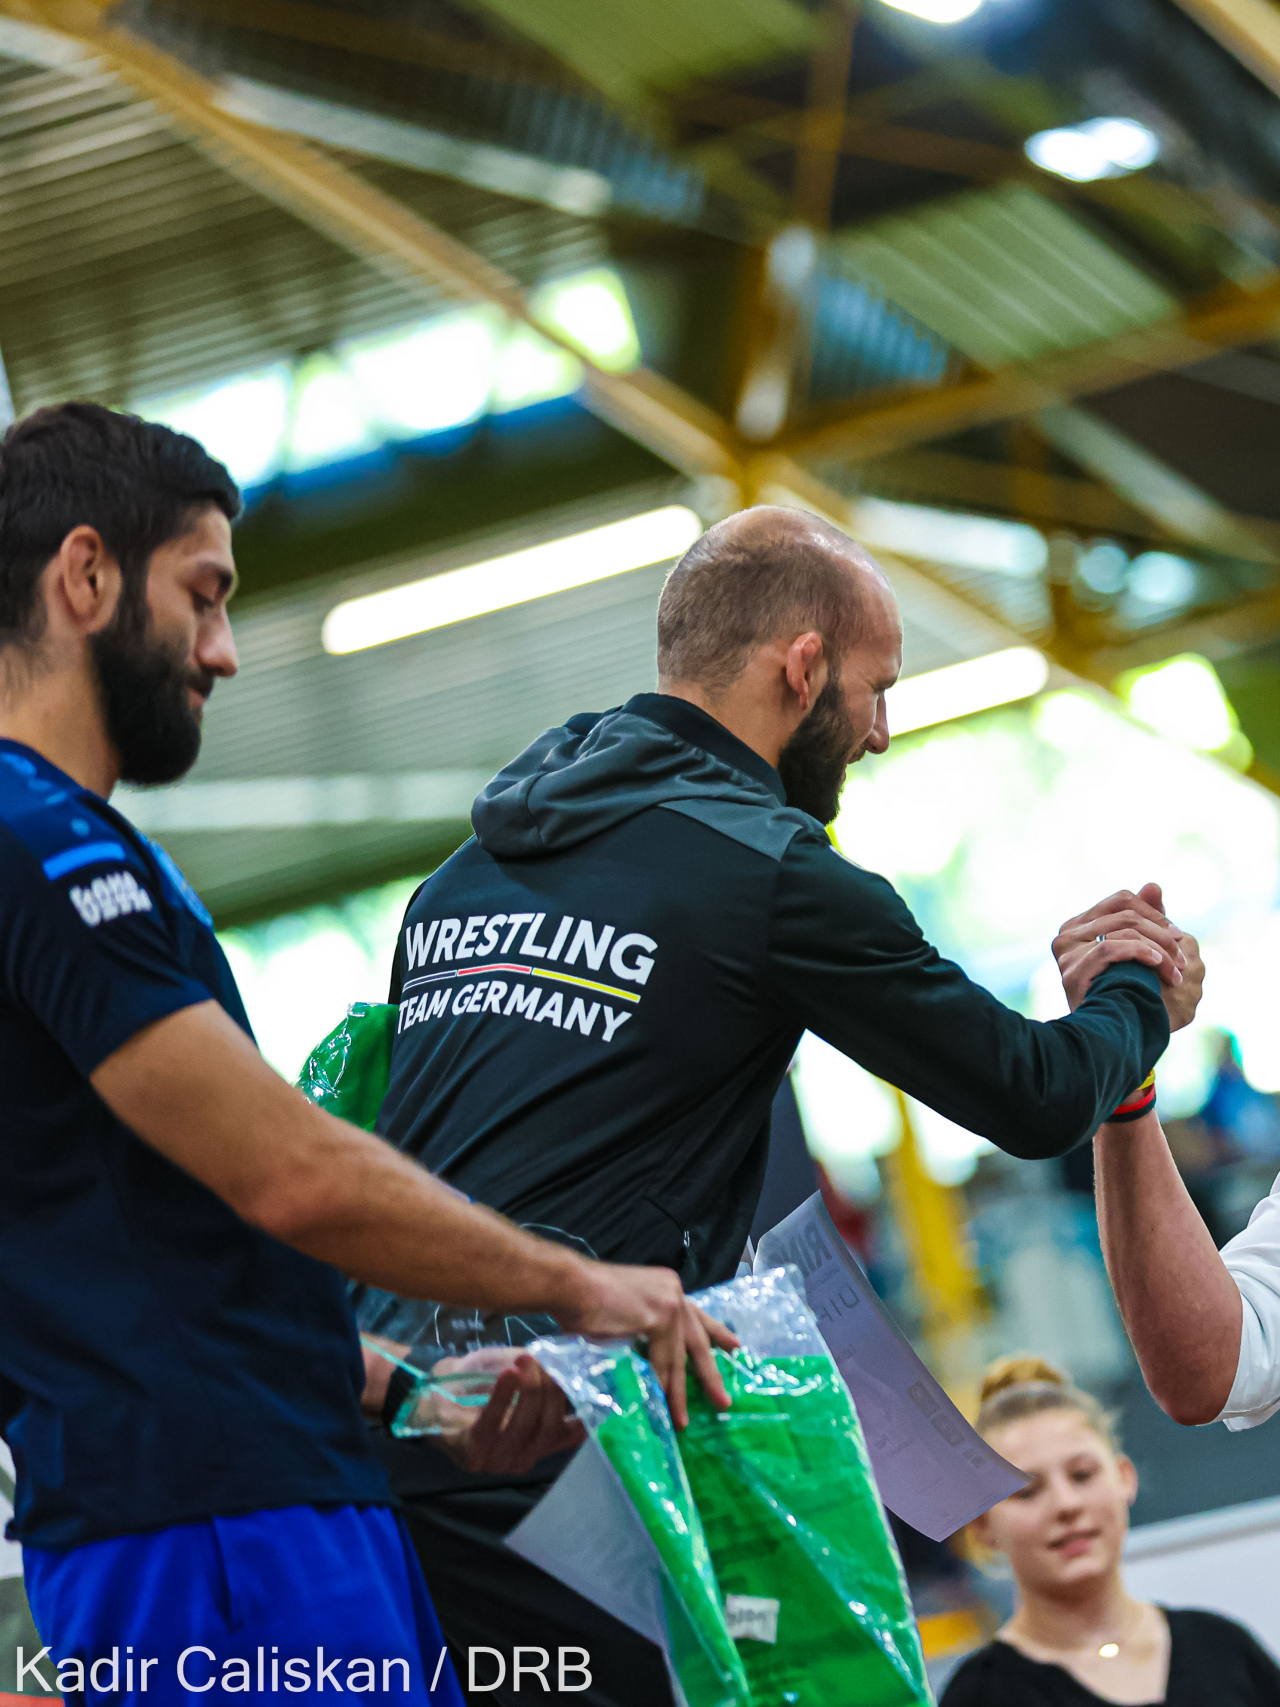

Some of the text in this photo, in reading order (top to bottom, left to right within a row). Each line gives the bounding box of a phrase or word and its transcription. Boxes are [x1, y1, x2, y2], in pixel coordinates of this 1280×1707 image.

[406, 913, 658, 985] WRESTLING
[398, 981, 632, 1042] TEAM GERMANY
